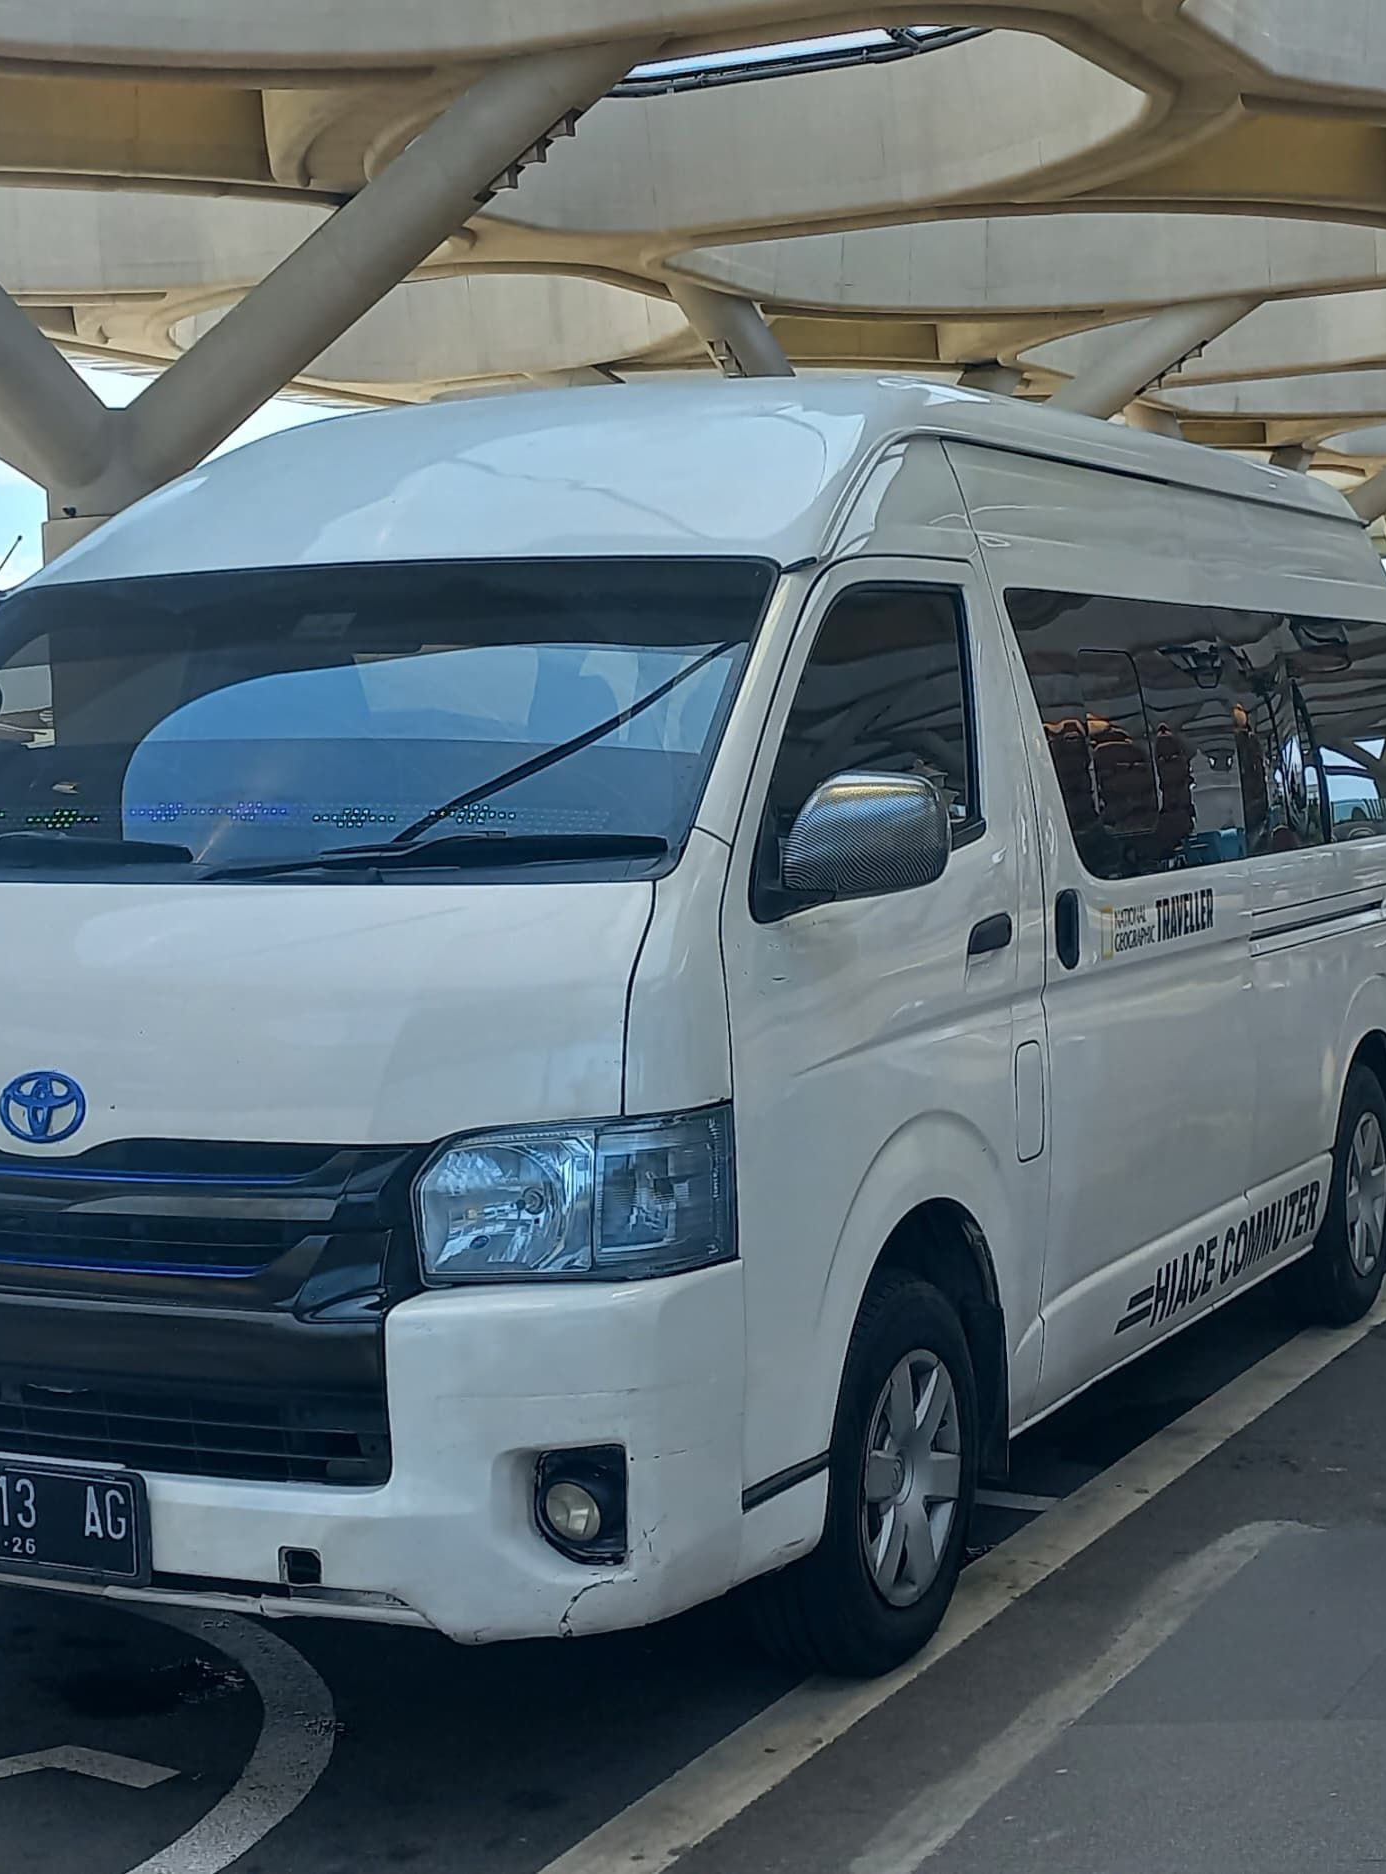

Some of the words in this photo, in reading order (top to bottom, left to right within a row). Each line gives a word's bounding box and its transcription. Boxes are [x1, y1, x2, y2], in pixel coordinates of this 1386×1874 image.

[1114, 904, 1147, 929] NATIONAL
[1114, 925, 1155, 952] GEOGRAPHIC
[1155, 888, 1214, 943] TRAVELLER
[1149, 1235, 1218, 1328] HIACE
[1219, 1180, 1320, 1285] COMMUTER
[84, 1485, 126, 1540] AG
